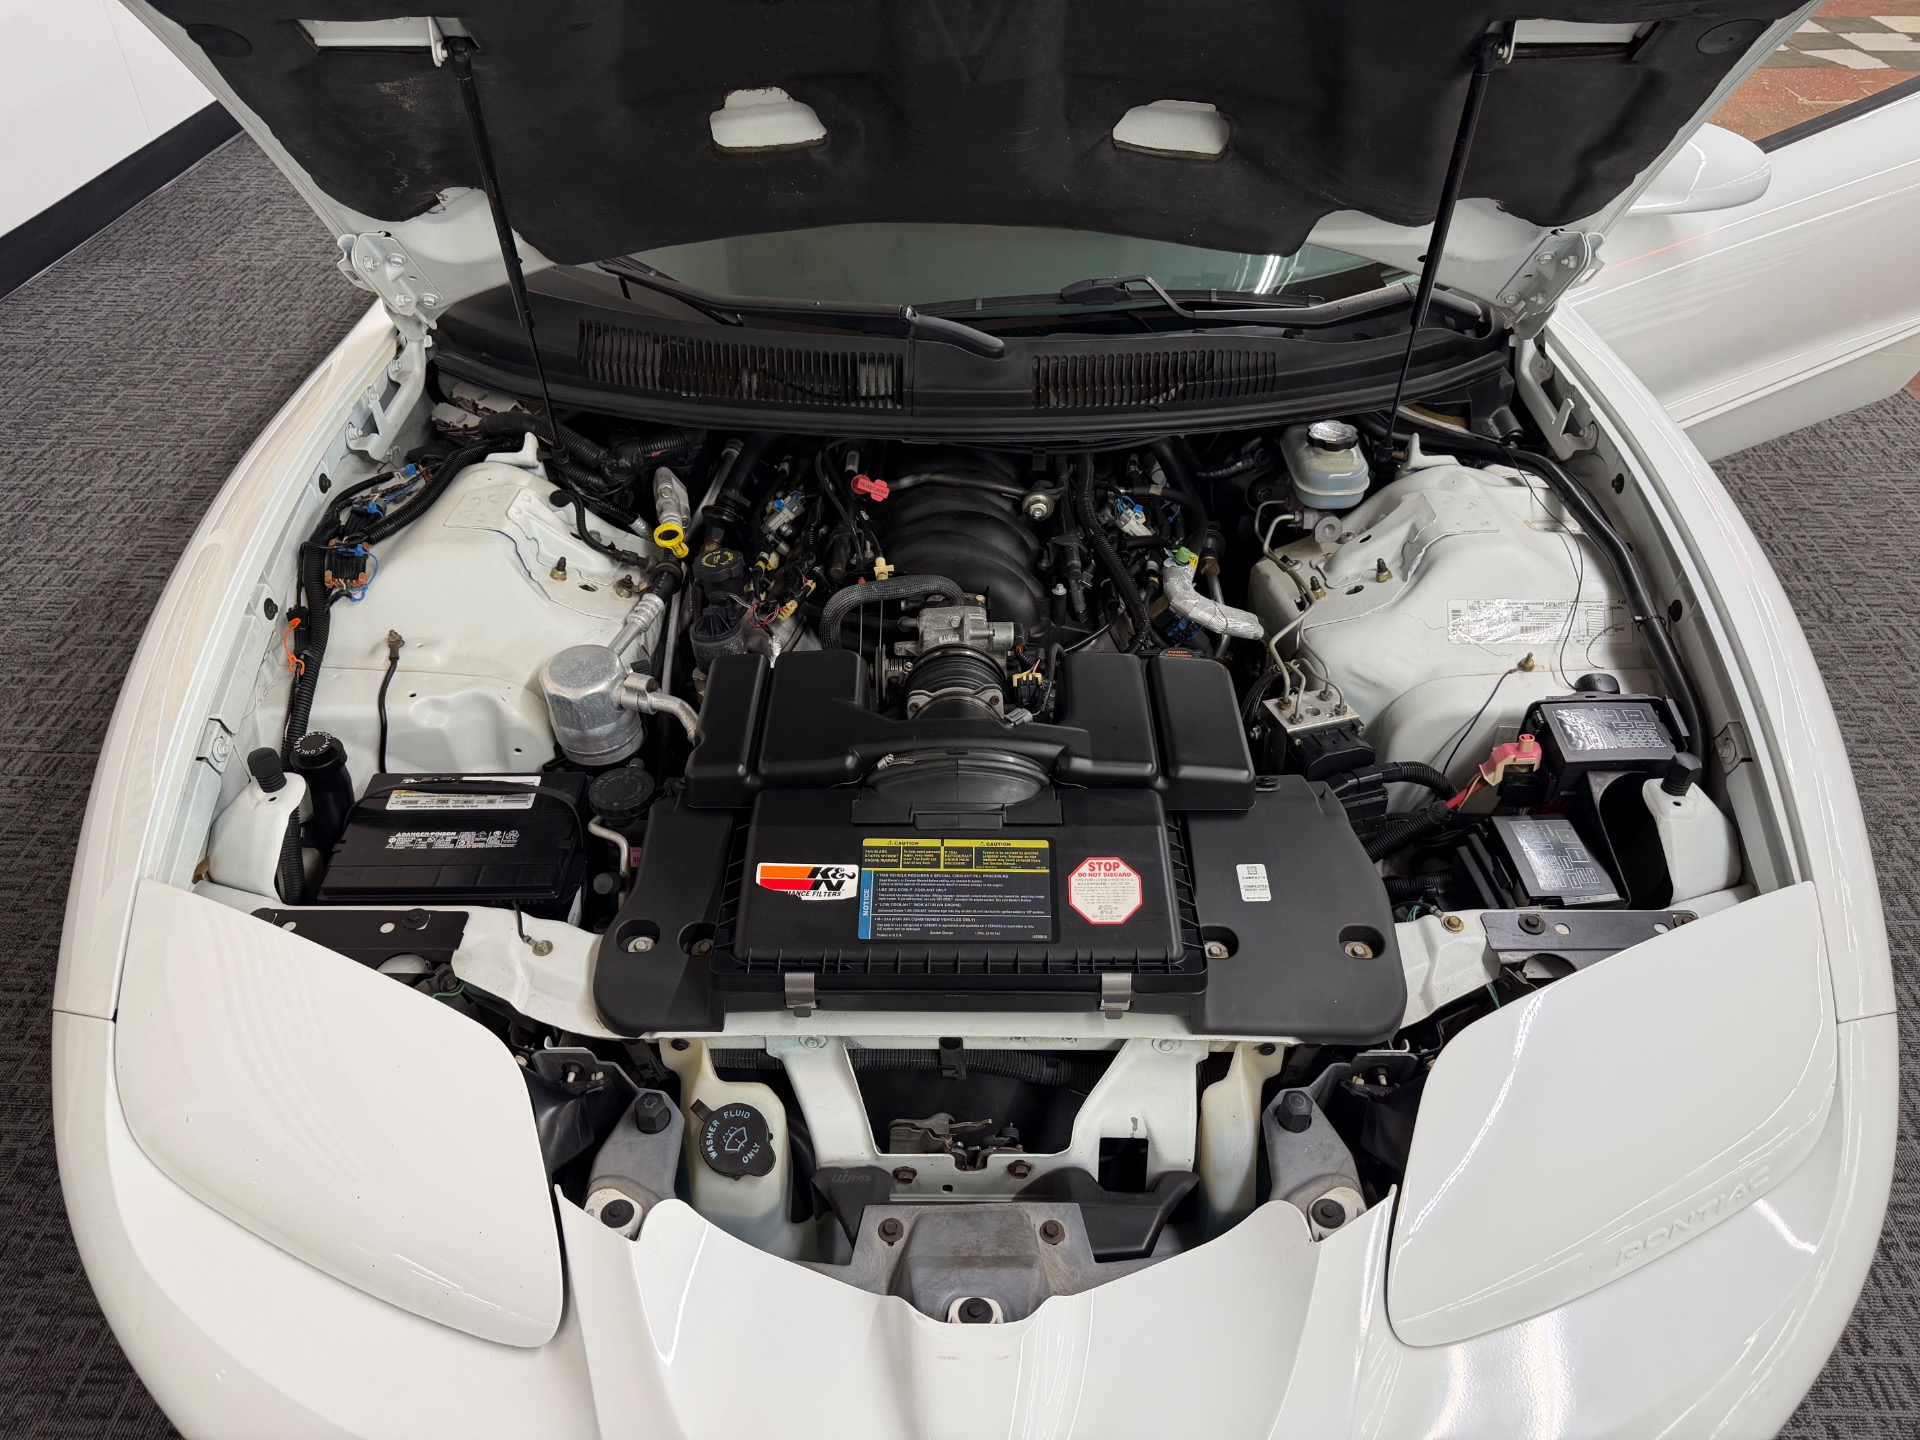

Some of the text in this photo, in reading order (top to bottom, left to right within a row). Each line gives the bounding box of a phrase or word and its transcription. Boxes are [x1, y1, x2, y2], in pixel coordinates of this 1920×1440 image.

[1088, 862, 1120, 871] STOP
[706, 1109, 760, 1163] WASHER FLUID ONLY
[1615, 1165, 1770, 1267] PONTIAC
